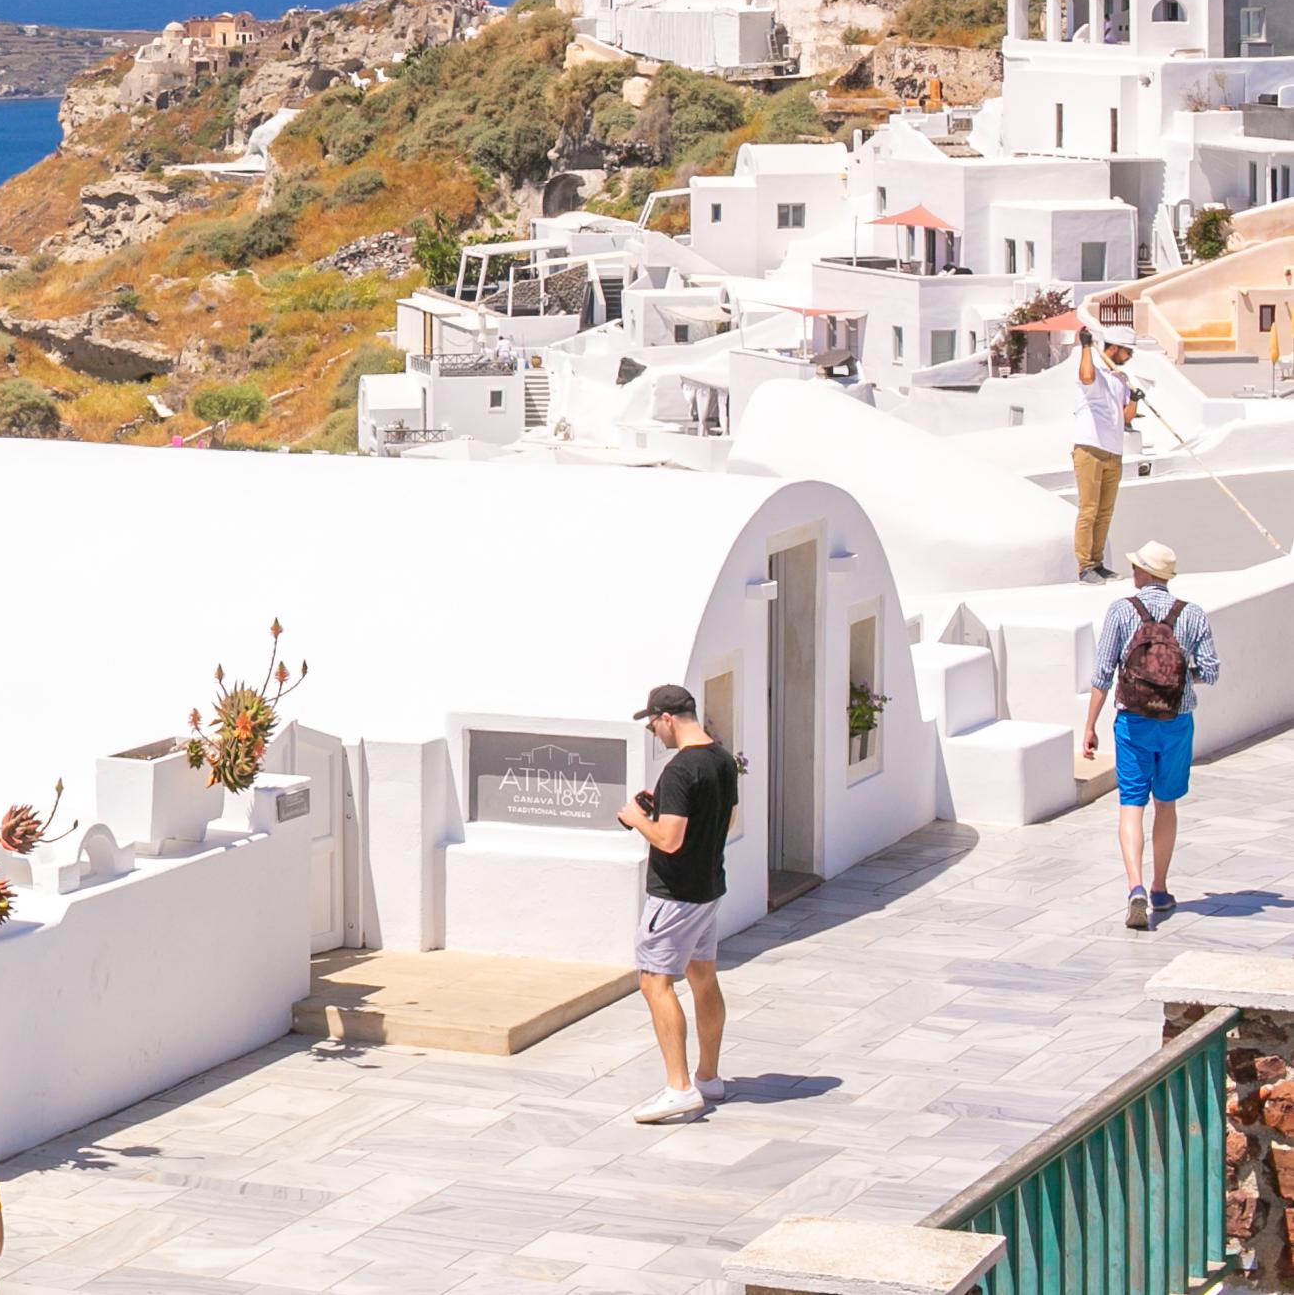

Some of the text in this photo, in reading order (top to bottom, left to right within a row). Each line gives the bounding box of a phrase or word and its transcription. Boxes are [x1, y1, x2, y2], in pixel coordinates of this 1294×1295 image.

[498, 767, 601, 796] ATRINA
[513, 788, 600, 808] CANAVA 1894
[507, 806, 592, 819] TRADITIONAL HOUSES
